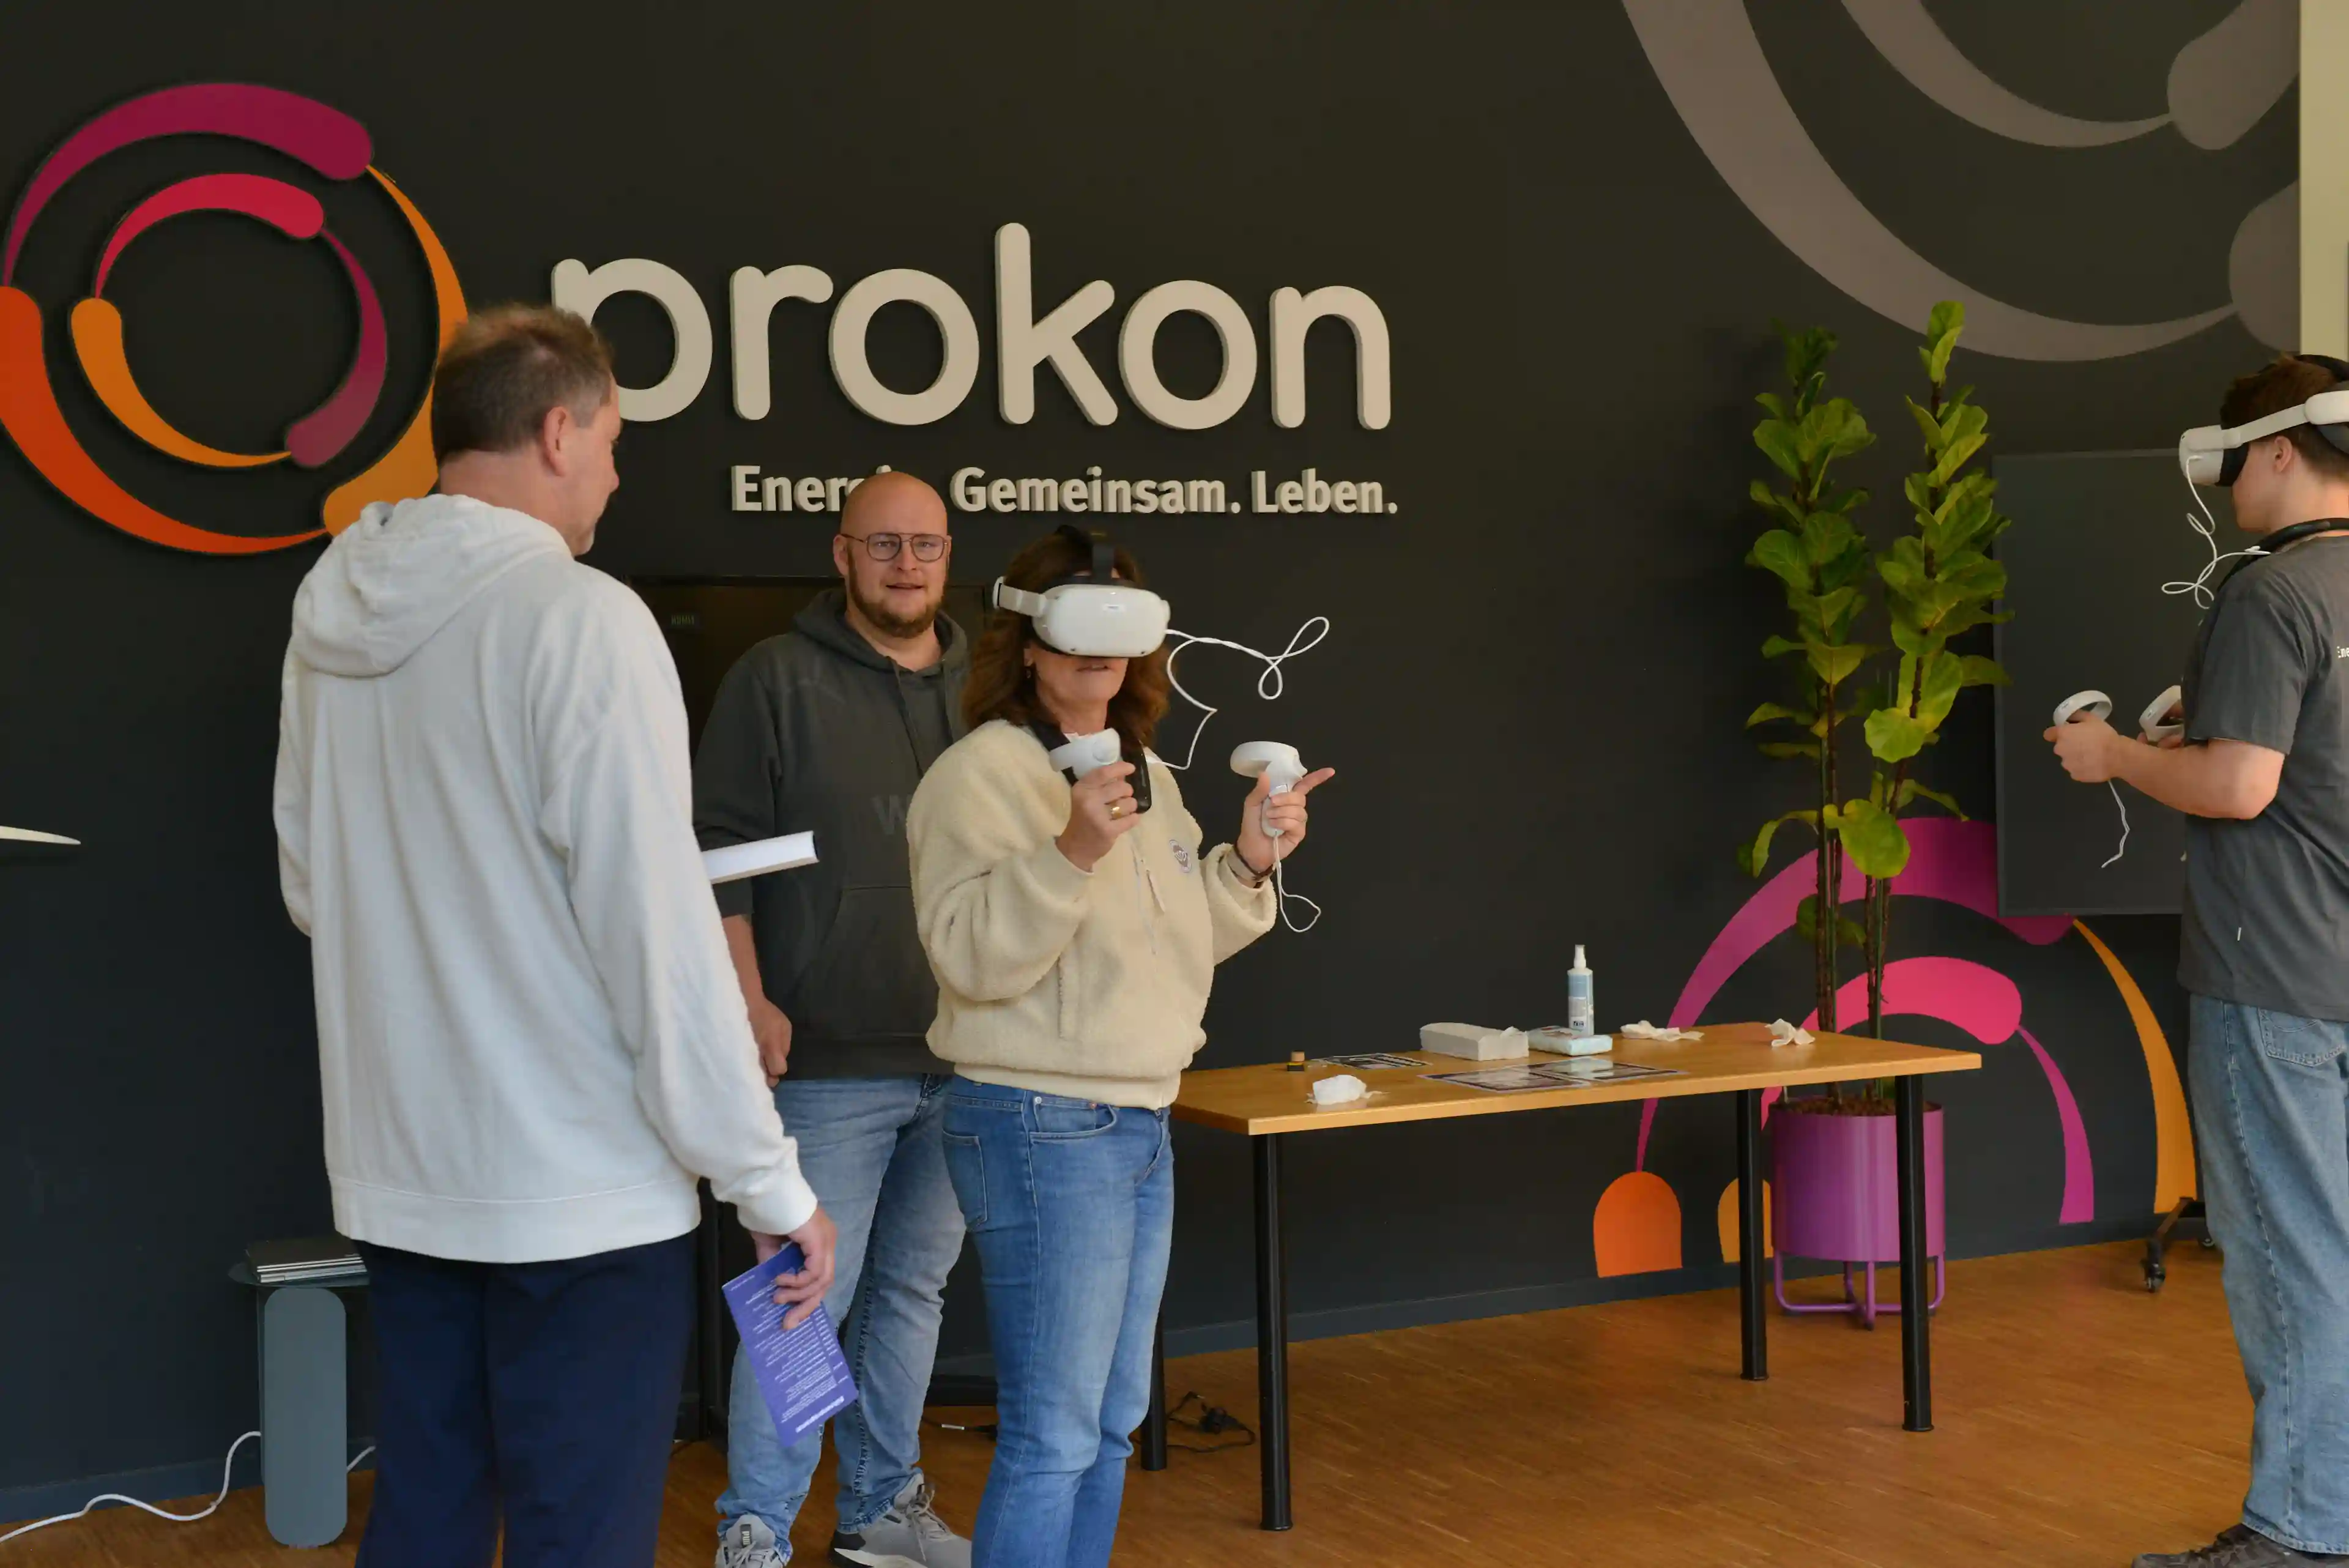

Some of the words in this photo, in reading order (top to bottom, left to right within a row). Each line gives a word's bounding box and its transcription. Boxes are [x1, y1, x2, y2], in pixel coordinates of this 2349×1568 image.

[551, 221, 1391, 429] prokon
[731, 464, 892, 512] Ener
[950, 466, 1241, 514] Gemeinsam.
[1251, 467, 1398, 514] Leben.
